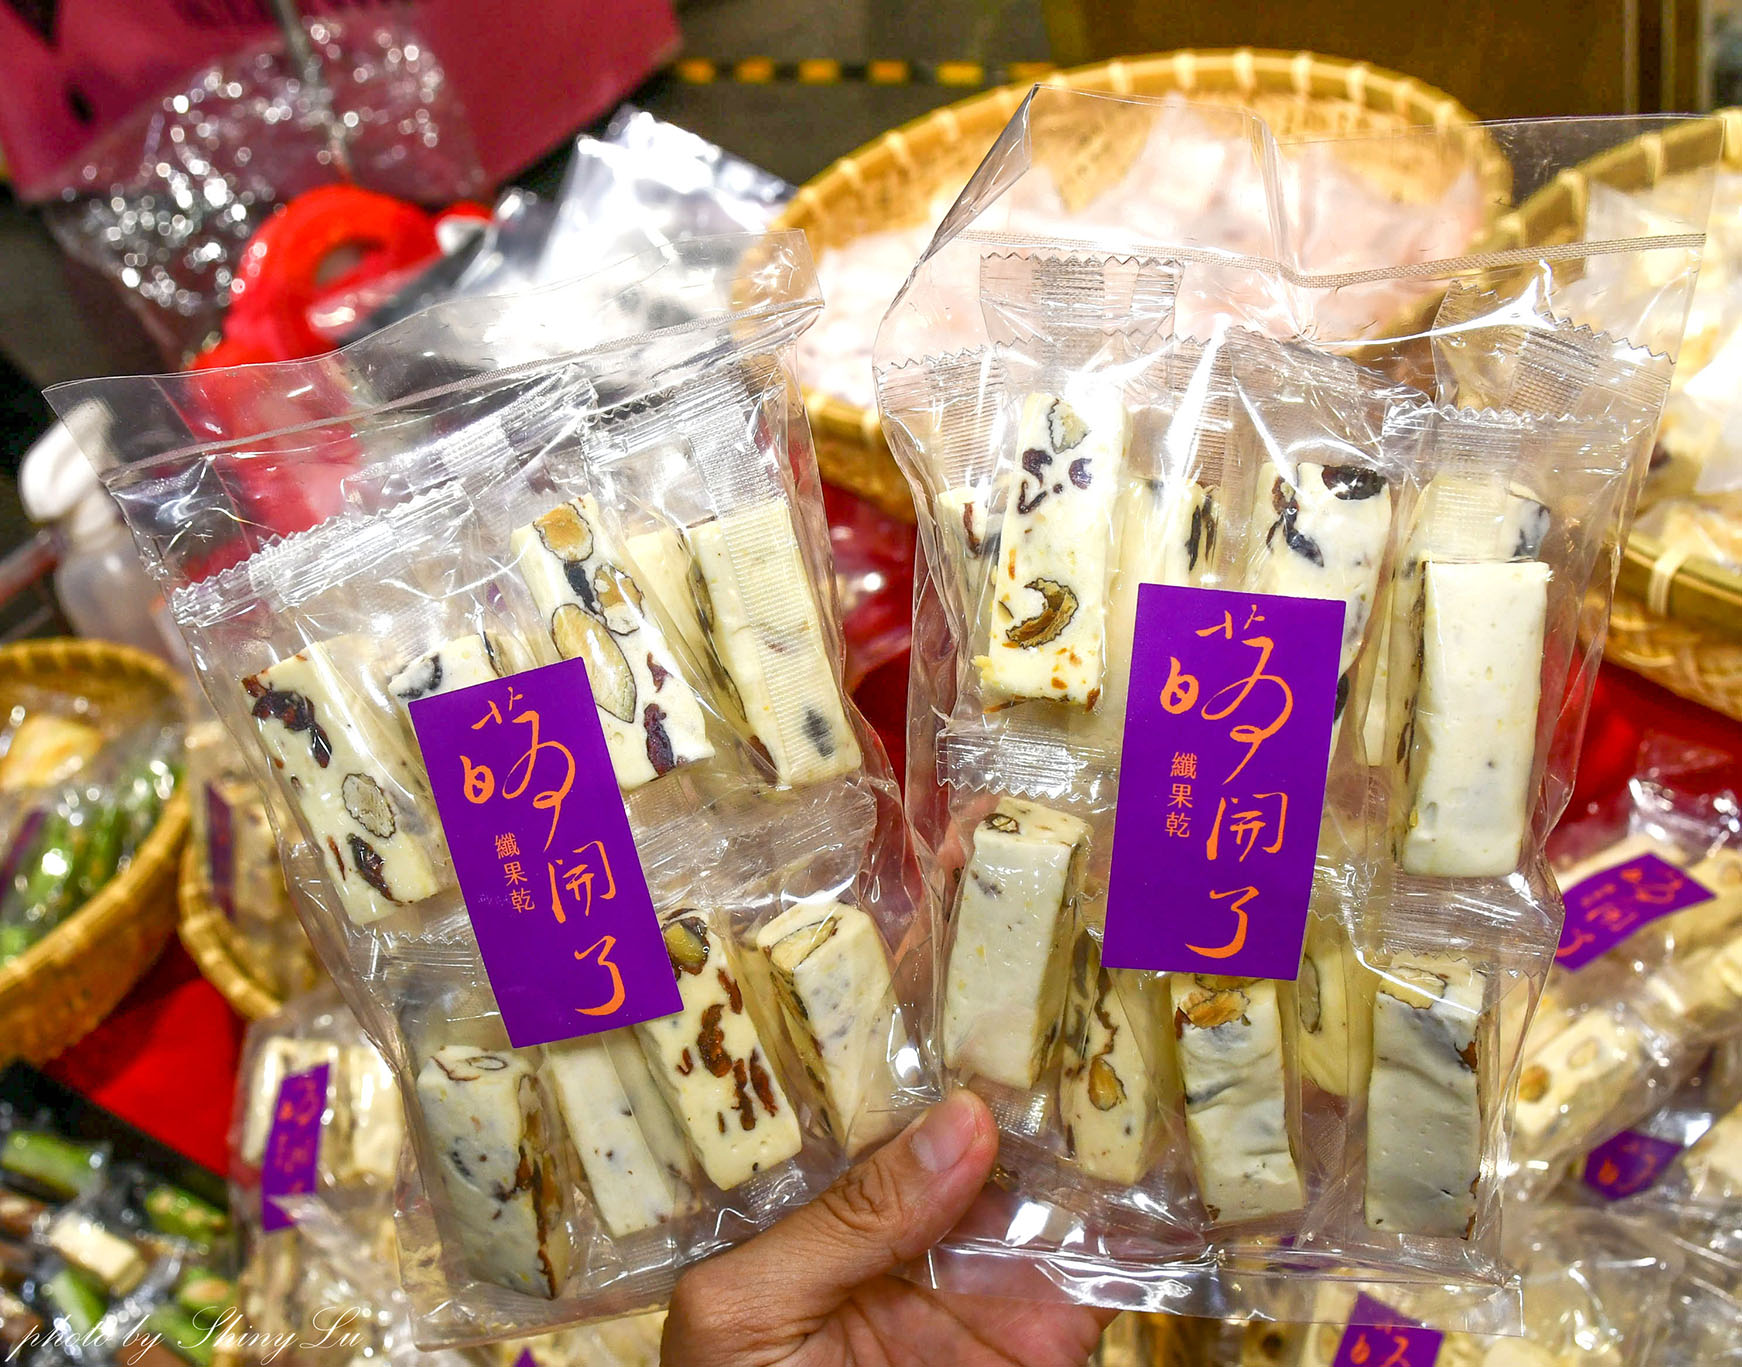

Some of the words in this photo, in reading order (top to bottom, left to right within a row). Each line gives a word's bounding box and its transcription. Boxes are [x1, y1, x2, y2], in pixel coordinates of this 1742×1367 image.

[1164, 751, 1198, 838] 纖果乾
[494, 832, 536, 913] 纖果乾
